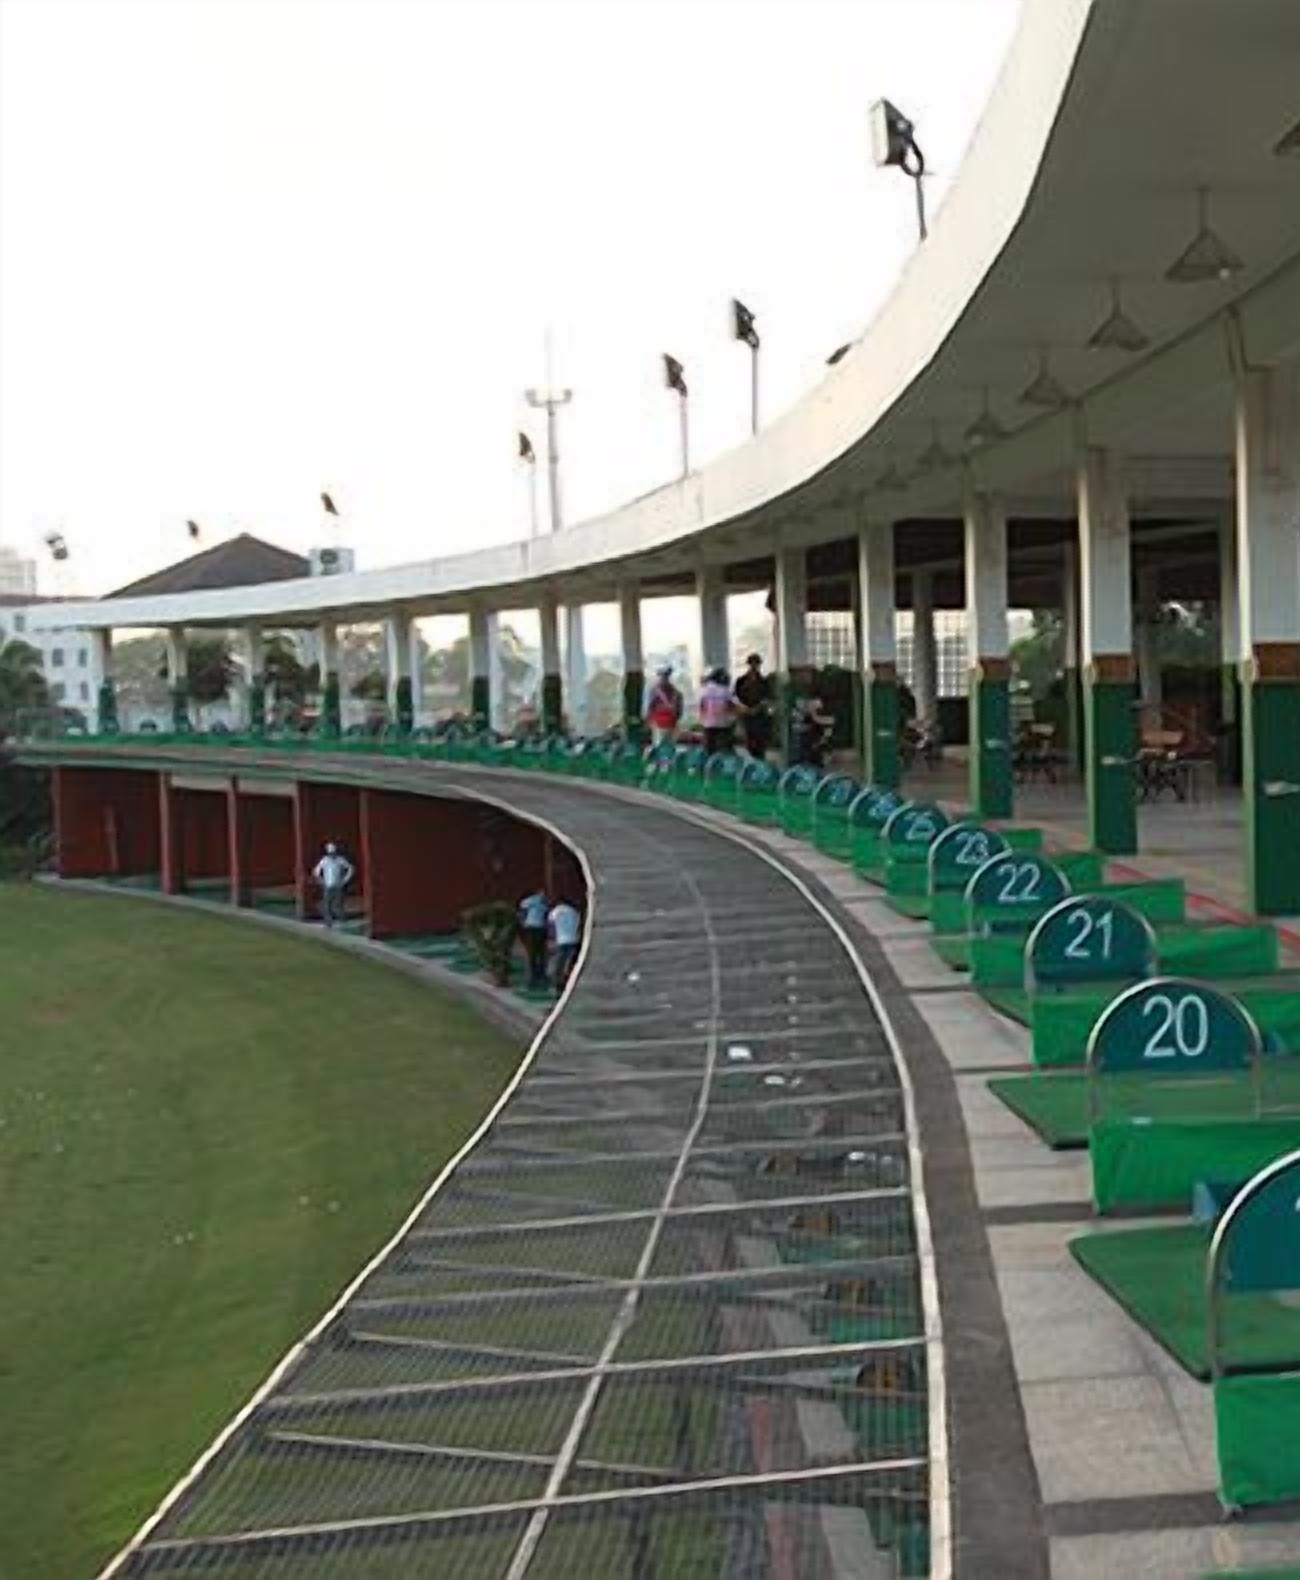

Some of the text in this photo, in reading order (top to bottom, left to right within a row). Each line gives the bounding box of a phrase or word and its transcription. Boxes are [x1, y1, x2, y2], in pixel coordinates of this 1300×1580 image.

[956, 831, 989, 864] 23
[998, 863, 1041, 902] 22
[1064, 908, 1114, 960] 21
[1142, 994, 1209, 1058] 20
